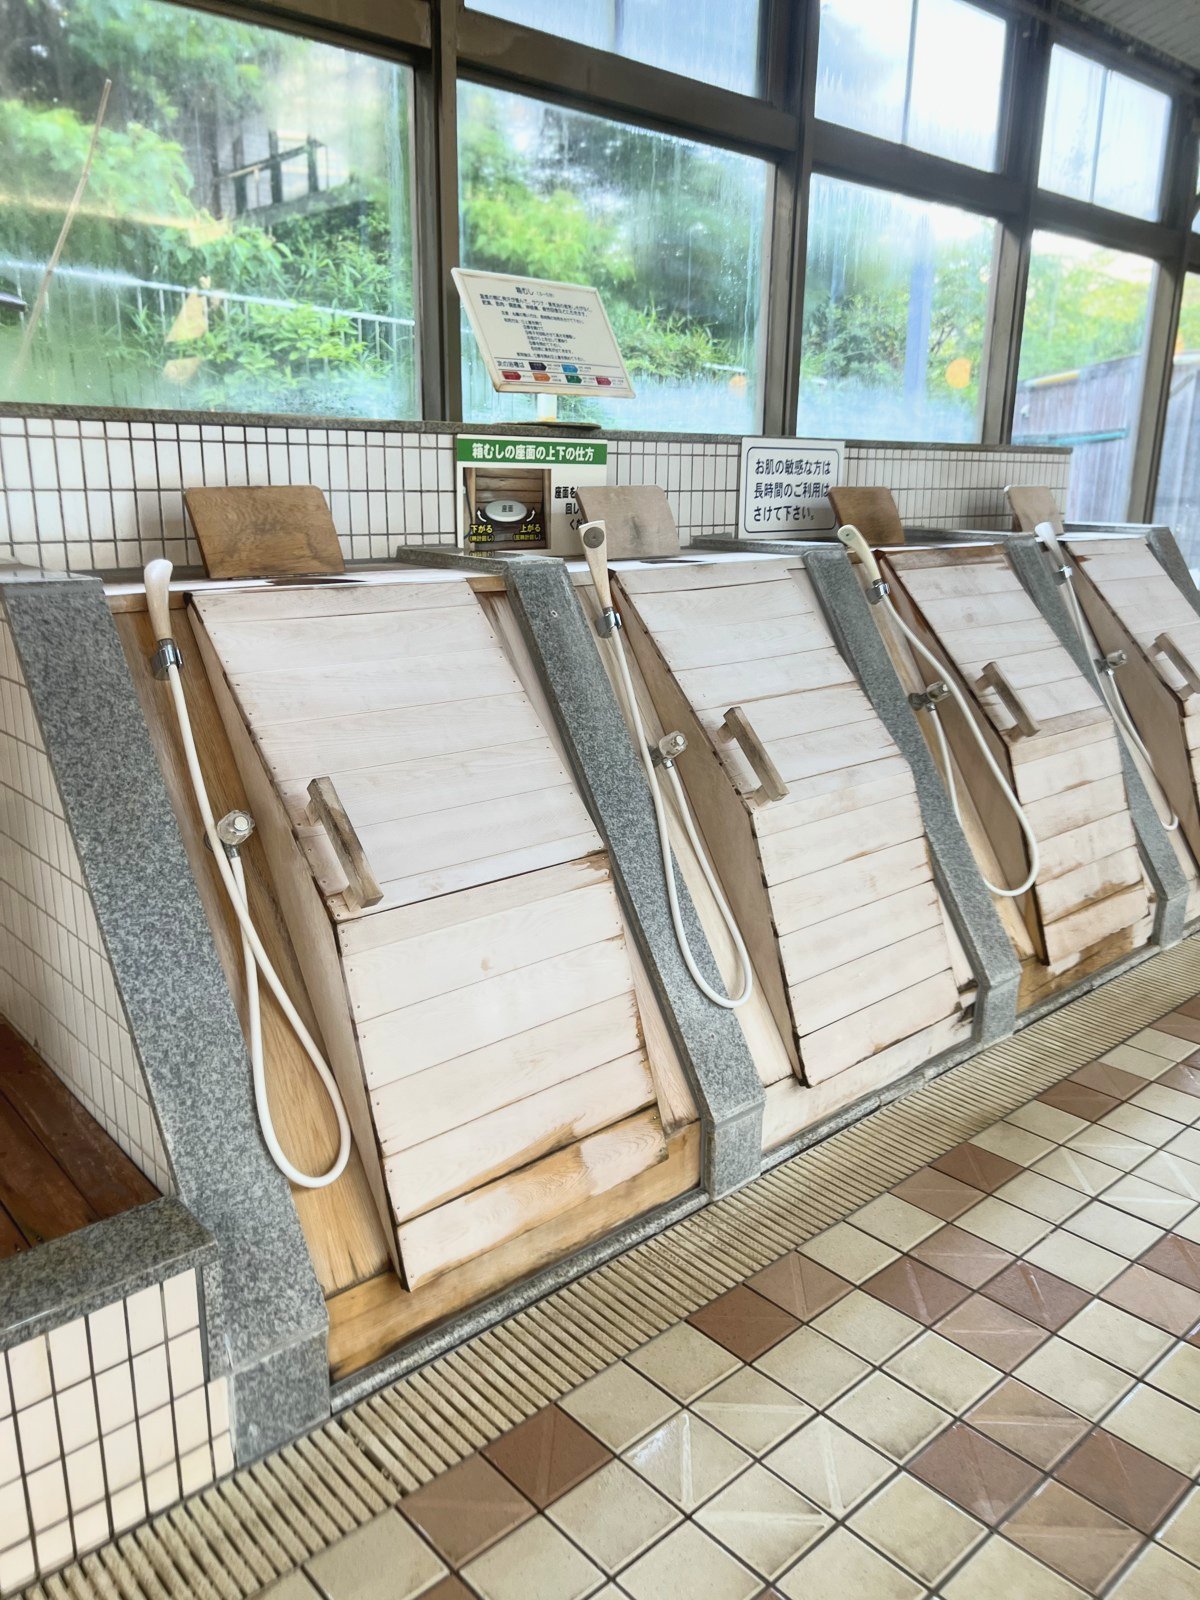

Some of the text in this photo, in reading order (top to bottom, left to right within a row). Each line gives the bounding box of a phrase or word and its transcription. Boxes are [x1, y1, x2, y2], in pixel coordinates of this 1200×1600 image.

[472, 442, 595, 462] 箱むしの座面の上下の仕方
[755, 458, 831, 476] お肌の敏感な方は
[554, 486, 579, 499] 座面を
[753, 482, 830, 499] 長時間のご利用は
[753, 505, 815, 522] さけて下さい。
[470, 524, 493, 534] 下がる
[520, 523, 541, 533] 上がる
